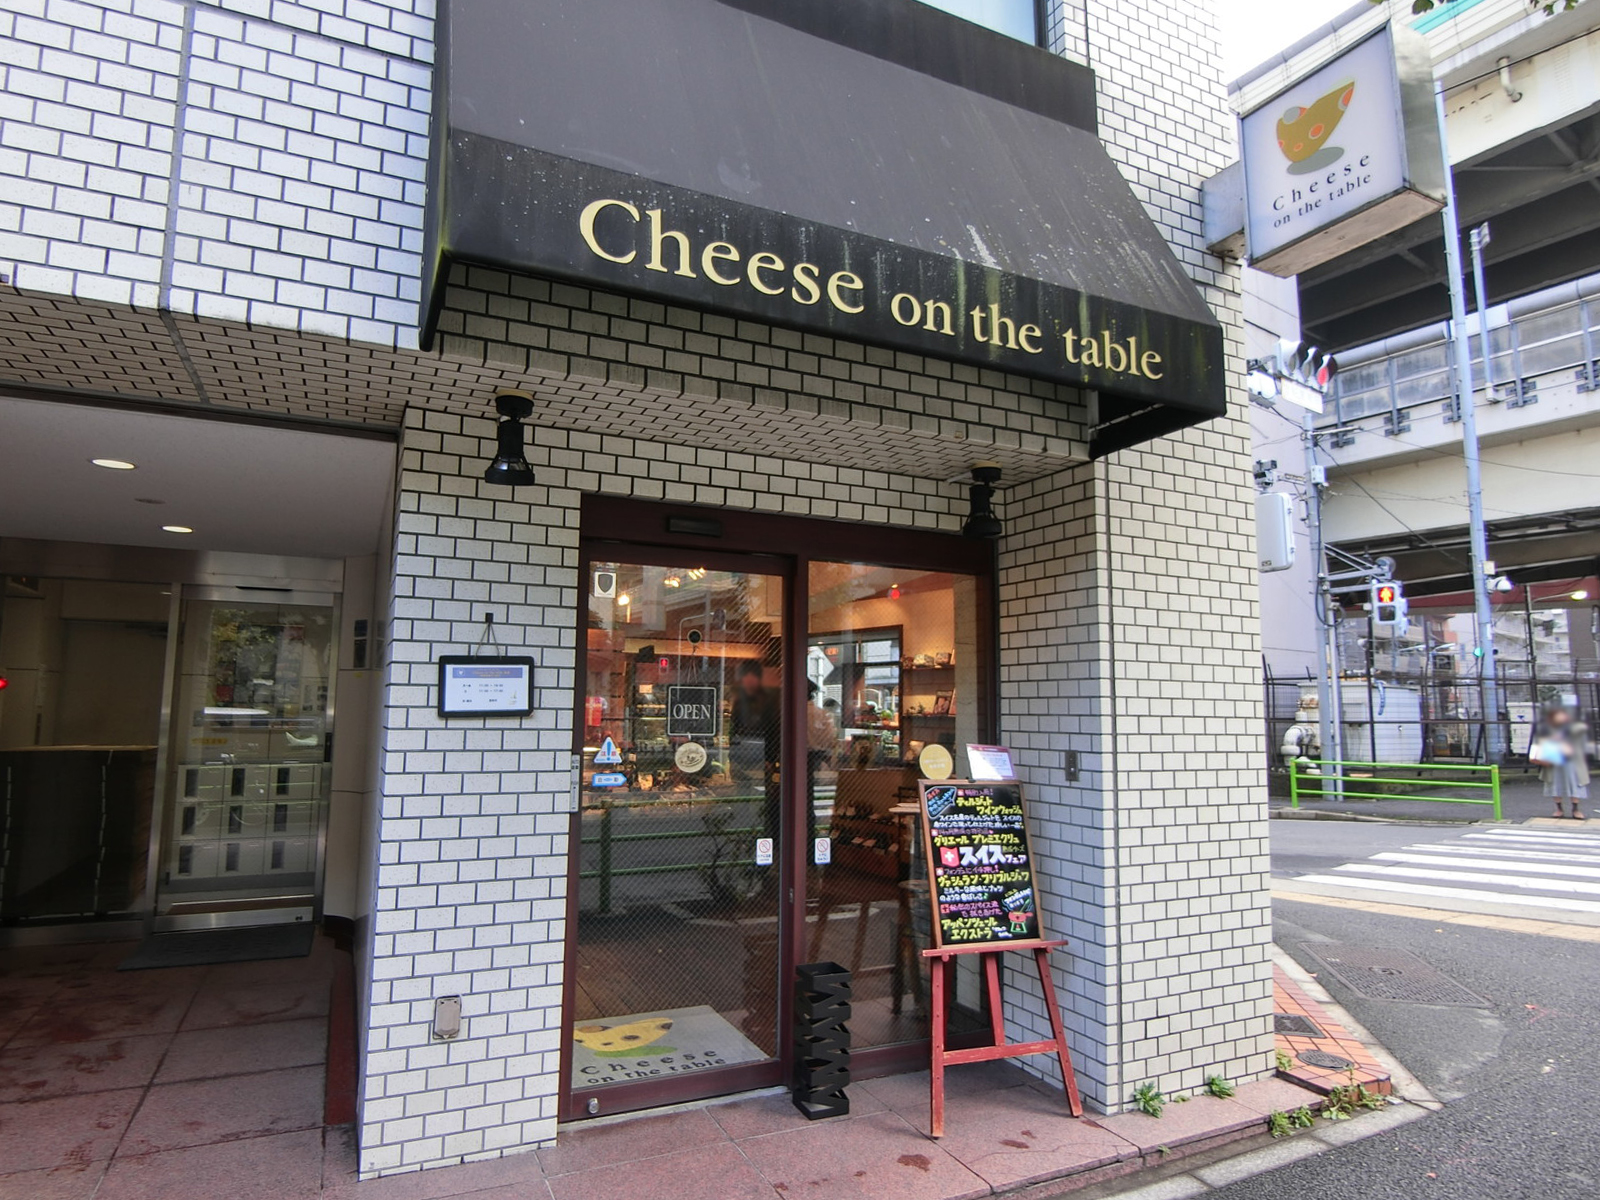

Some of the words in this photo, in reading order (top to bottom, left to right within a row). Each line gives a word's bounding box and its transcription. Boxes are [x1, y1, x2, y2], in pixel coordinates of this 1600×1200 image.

[1272, 154, 1370, 211] Cheese
[1273, 213, 1291, 229] on
[1298, 198, 1322, 216] the
[1329, 173, 1371, 201] table
[578, 198, 865, 315] Cheese
[890, 292, 957, 337] on
[970, 302, 1044, 354] the
[1062, 325, 1164, 381] table
[673, 703, 711, 720] OPEN
[959, 845, 1006, 866] スイス
[1005, 854, 1027, 864] フェア
[951, 926, 992, 940] エクストラ
[579, 1049, 718, 1075] Cheese
[586, 1073, 614, 1084] on
[625, 1067, 662, 1079] the
[669, 1057, 727, 1073] table
